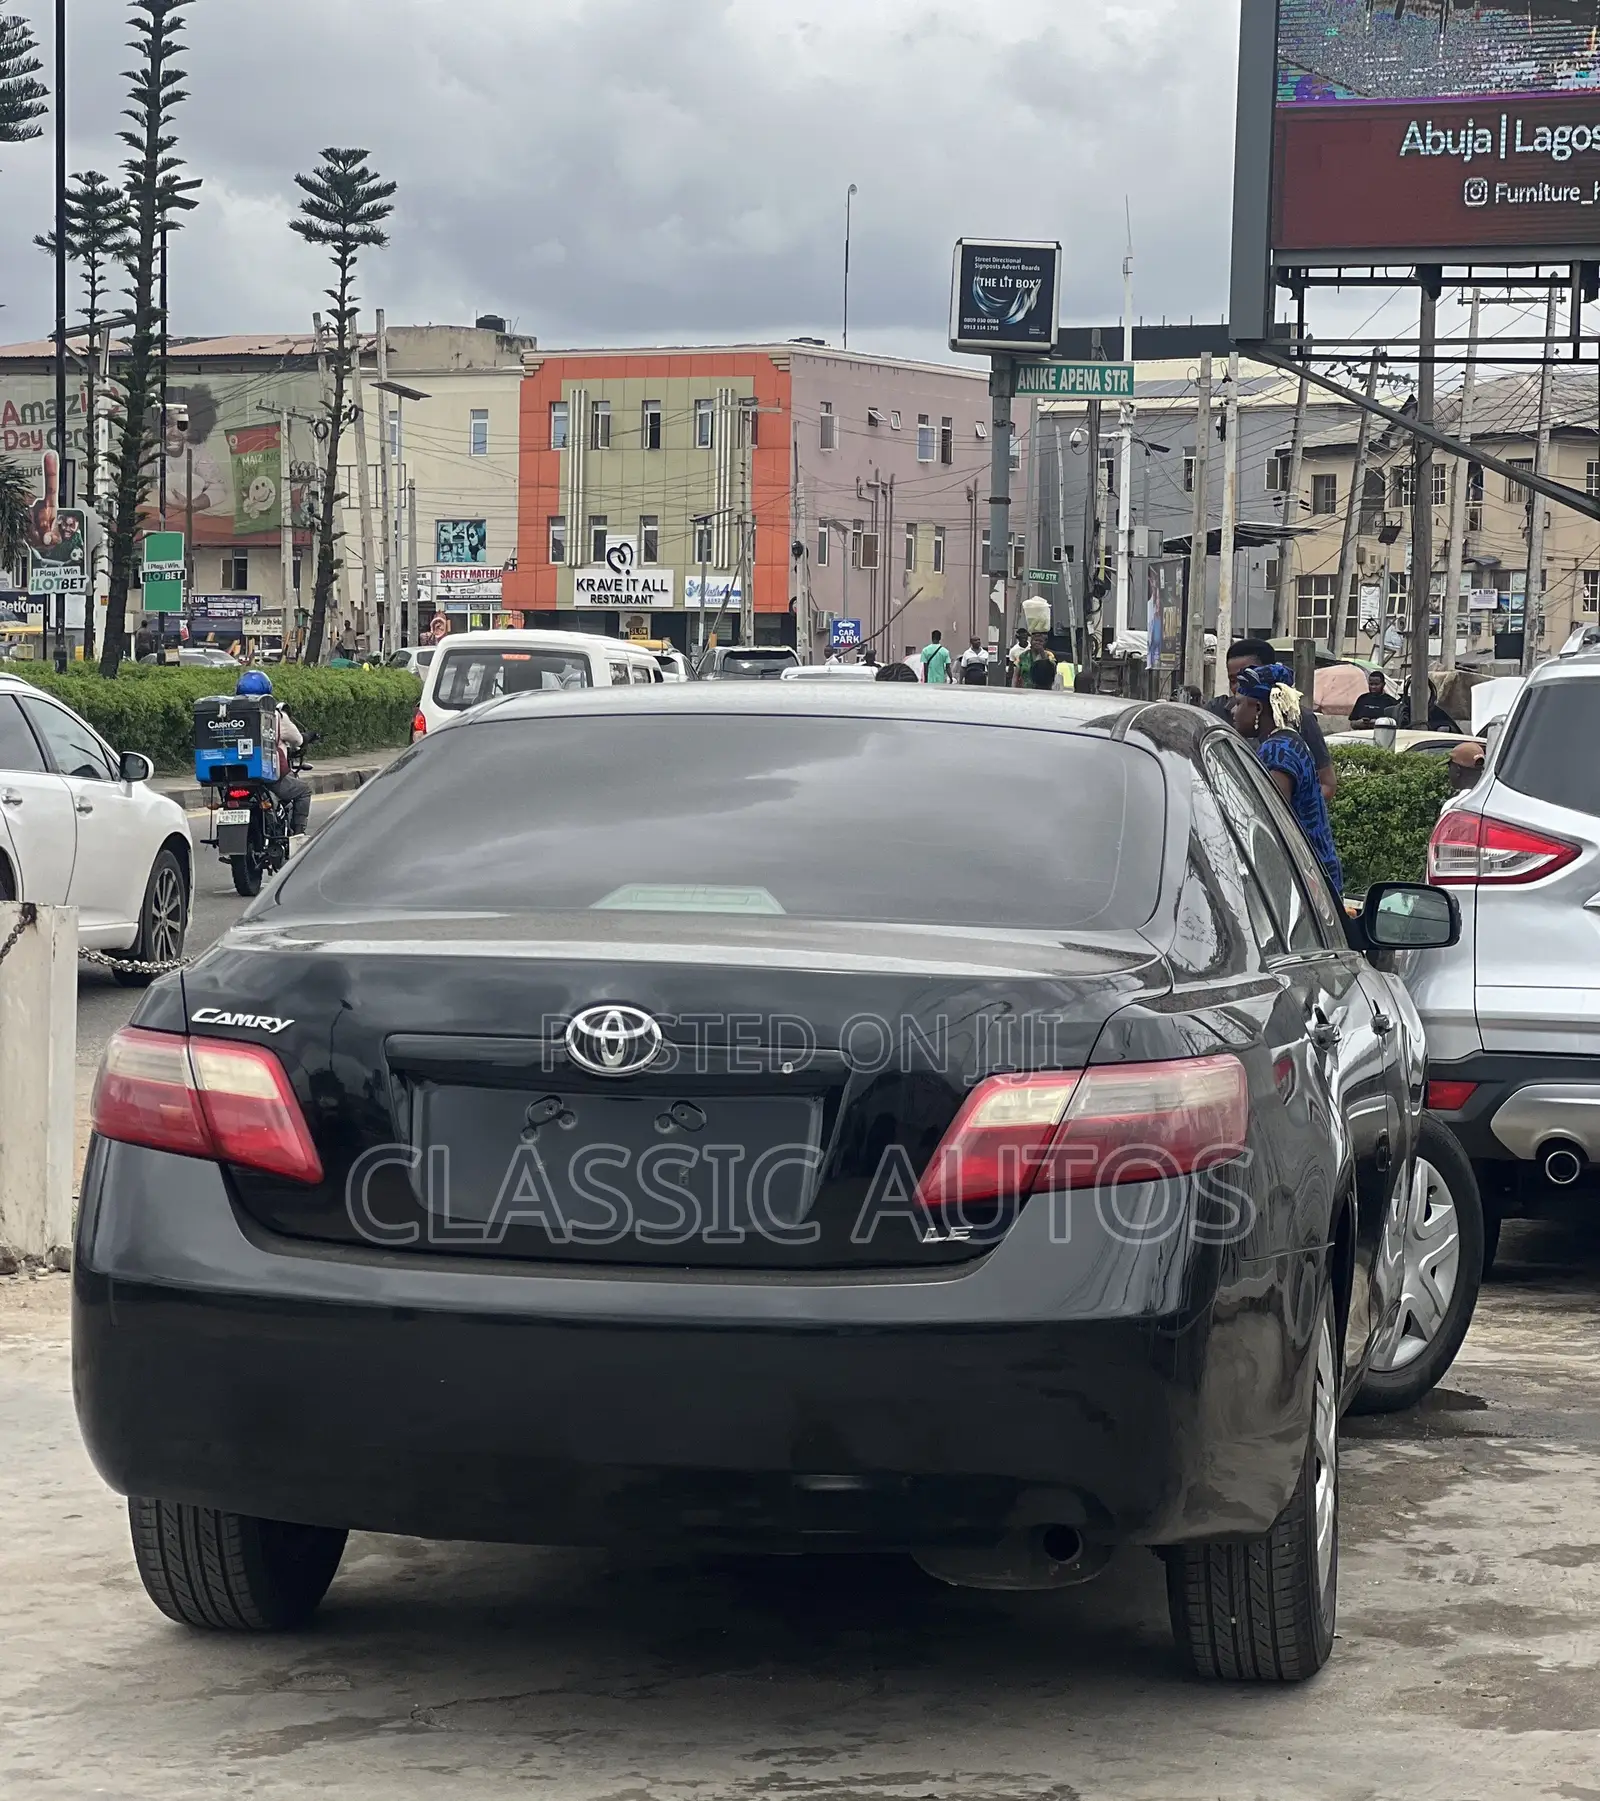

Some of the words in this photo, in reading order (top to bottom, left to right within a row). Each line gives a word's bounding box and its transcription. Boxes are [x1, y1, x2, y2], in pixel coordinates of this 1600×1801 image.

[1400, 118, 1492, 162] Abuja
[1515, 119, 1600, 161] Lagos
[1018, 368, 1057, 390] ANIKE
[1060, 368, 1101, 391] APENA
[1104, 369, 1129, 392] STR
[4, 429, 43, 451] Day
[145, 571, 183, 581] iLOTBET
[440, 569, 468, 579] SAFETY
[31, 578, 86, 591] iLOTBET
[577, 578, 622, 592] KRAVE
[626, 578, 639, 591] IT
[641, 579, 668, 592] ALL
[590, 594, 654, 604] RESTAURANT
[0, 601, 43, 613] BetKing
[191, 1008, 295, 1033] CAMRY
[923, 1226, 973, 1242] LE
